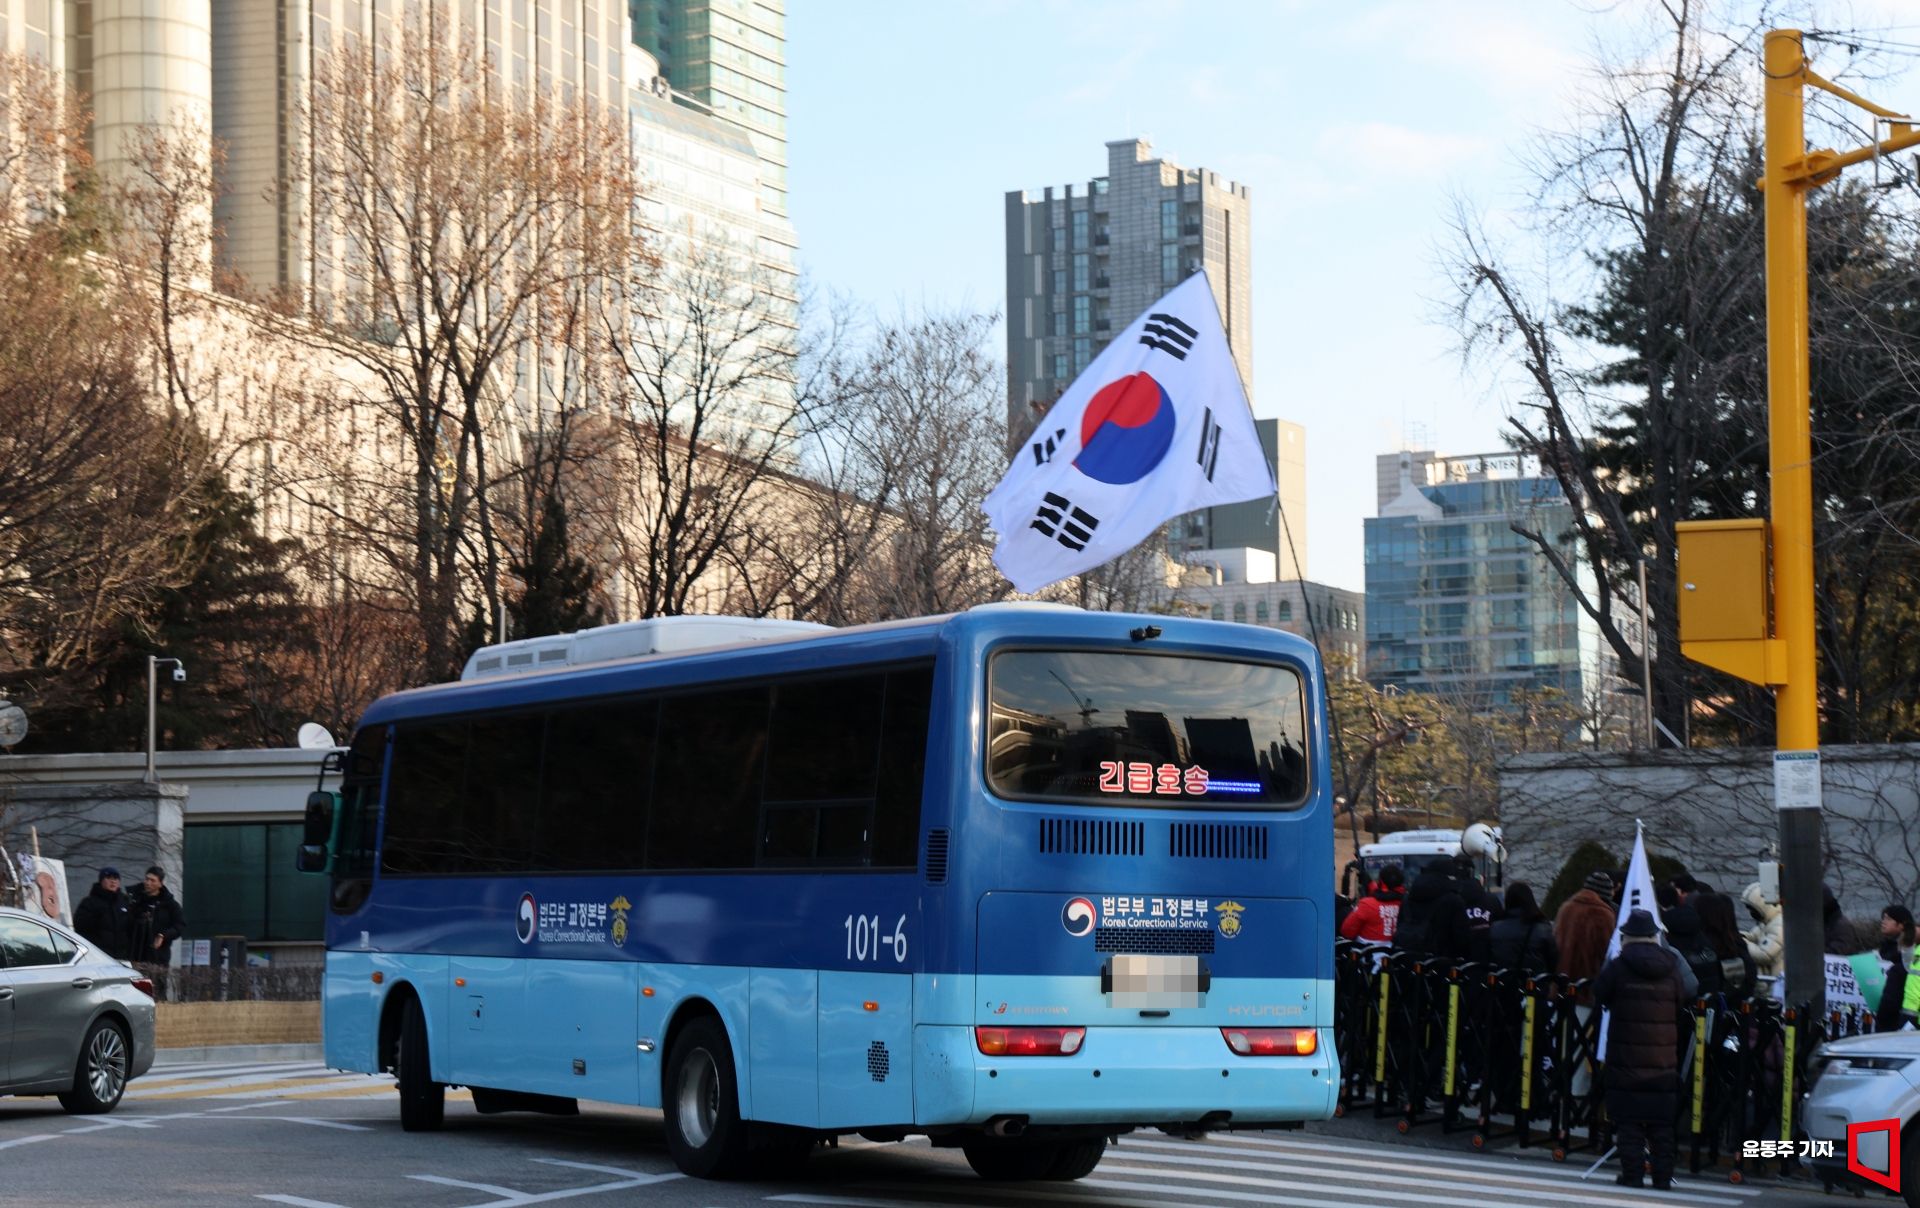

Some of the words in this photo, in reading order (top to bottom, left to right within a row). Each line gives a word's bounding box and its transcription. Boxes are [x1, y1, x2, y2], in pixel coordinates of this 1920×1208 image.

[1099, 761, 1209, 795] 긴급호송
[540, 903, 566, 928] 법무부
[568, 903, 607, 928] 교정본부
[1102, 896, 1145, 916] 법무부
[1150, 898, 1209, 918] 교정본부
[1102, 916, 1126, 928] Korea
[1127, 917, 1178, 928] Correctional
[1179, 918, 1208, 928] Service
[539, 928, 554, 942] Korea
[586, 930, 606, 943] Service
[844, 913, 907, 963] 101-6
[1826, 962, 1856, 978] 대한
